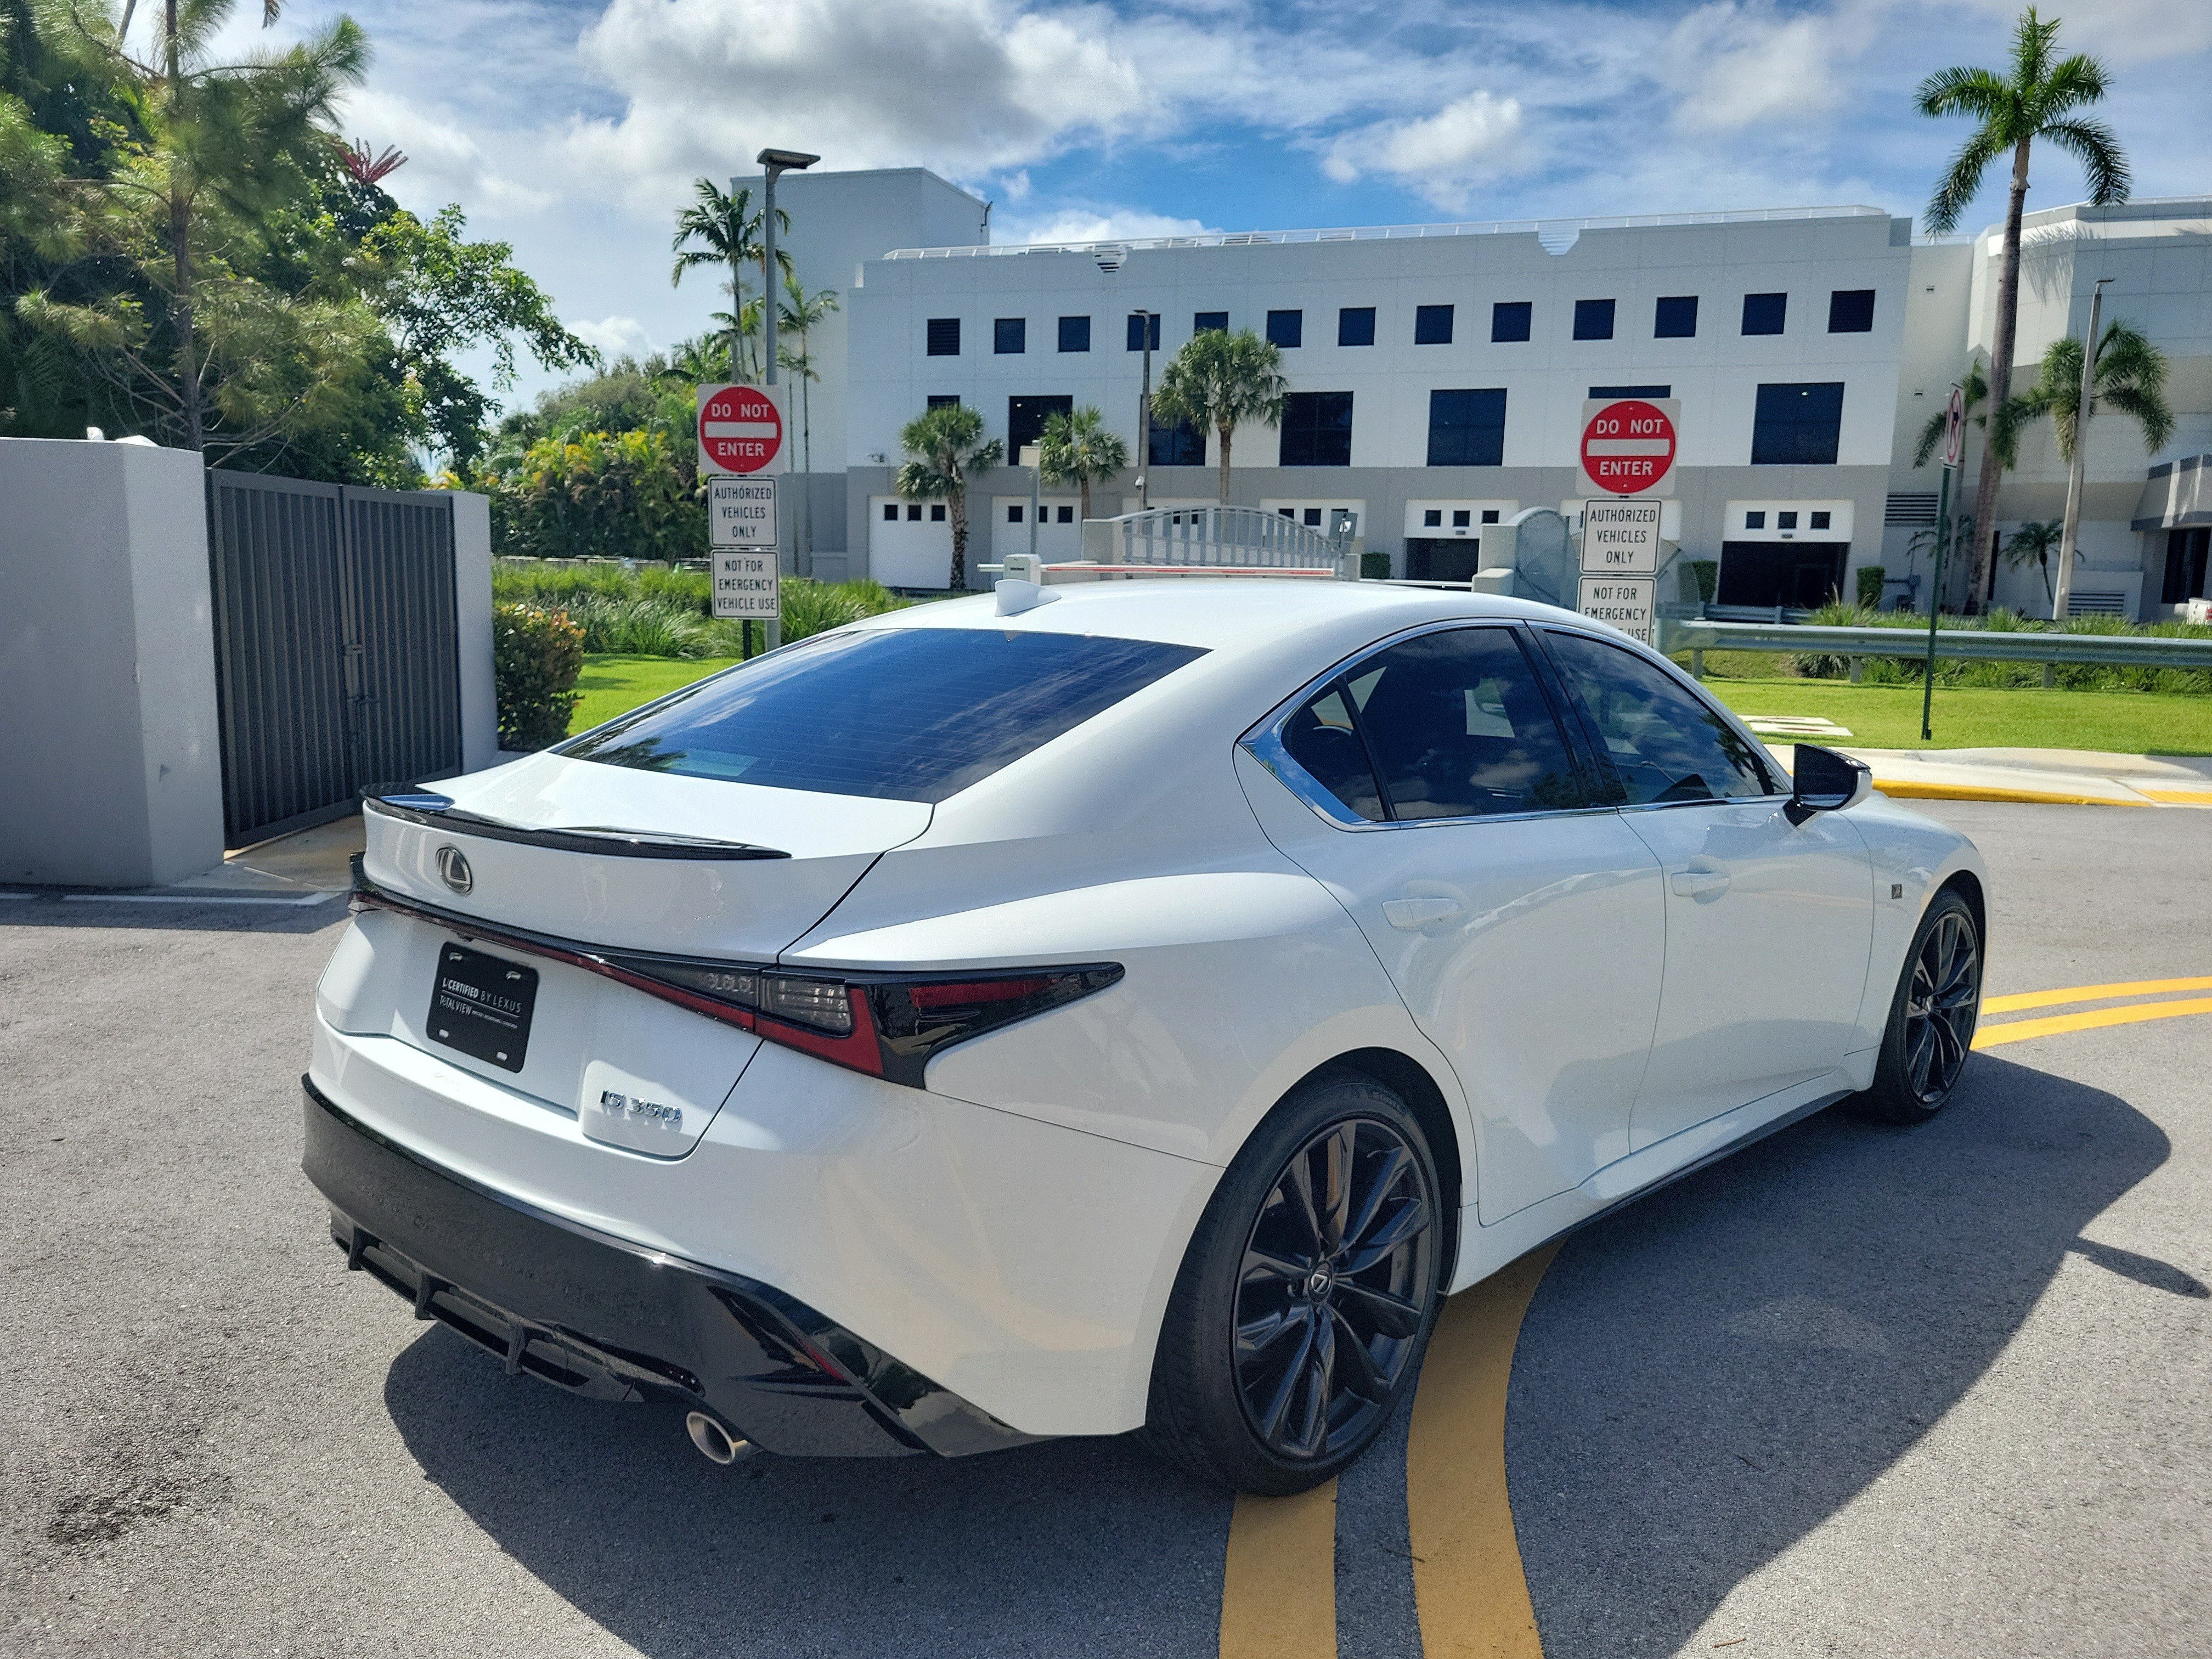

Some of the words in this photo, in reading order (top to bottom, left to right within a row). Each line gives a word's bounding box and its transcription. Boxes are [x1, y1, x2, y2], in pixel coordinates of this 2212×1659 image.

[712, 404, 731, 417] DO
[741, 404, 770, 418] NOT
[1596, 419, 1619, 435] DO
[1630, 419, 1663, 434] NOT
[718, 442, 764, 456] ENTER
[1599, 461, 1652, 476] ENTER
[714, 487, 772, 500] AUTHORIZED
[721, 506, 765, 519] VEHICLES
[1590, 509, 1656, 522] AUTHORIZED
[732, 526, 757, 538] ONLY
[1596, 530, 1646, 543] VEHICLES
[1606, 551, 1634, 564] ONLY
[725, 560, 741, 572] NOT
[746, 560, 763, 572] FOR
[719, 578, 773, 591] EMERGENCY
[1593, 587, 1613, 599] NOT
[1617, 587, 1637, 600] FOR
[718, 597, 754, 610] VEHICLE
[758, 597, 776, 610] USE
[1584, 607, 1646, 620] EMERGENCY
[481, 990, 492, 1002] BY
[493, 995, 522, 1014] LEXUS
[627, 1097, 683, 1122] 350
